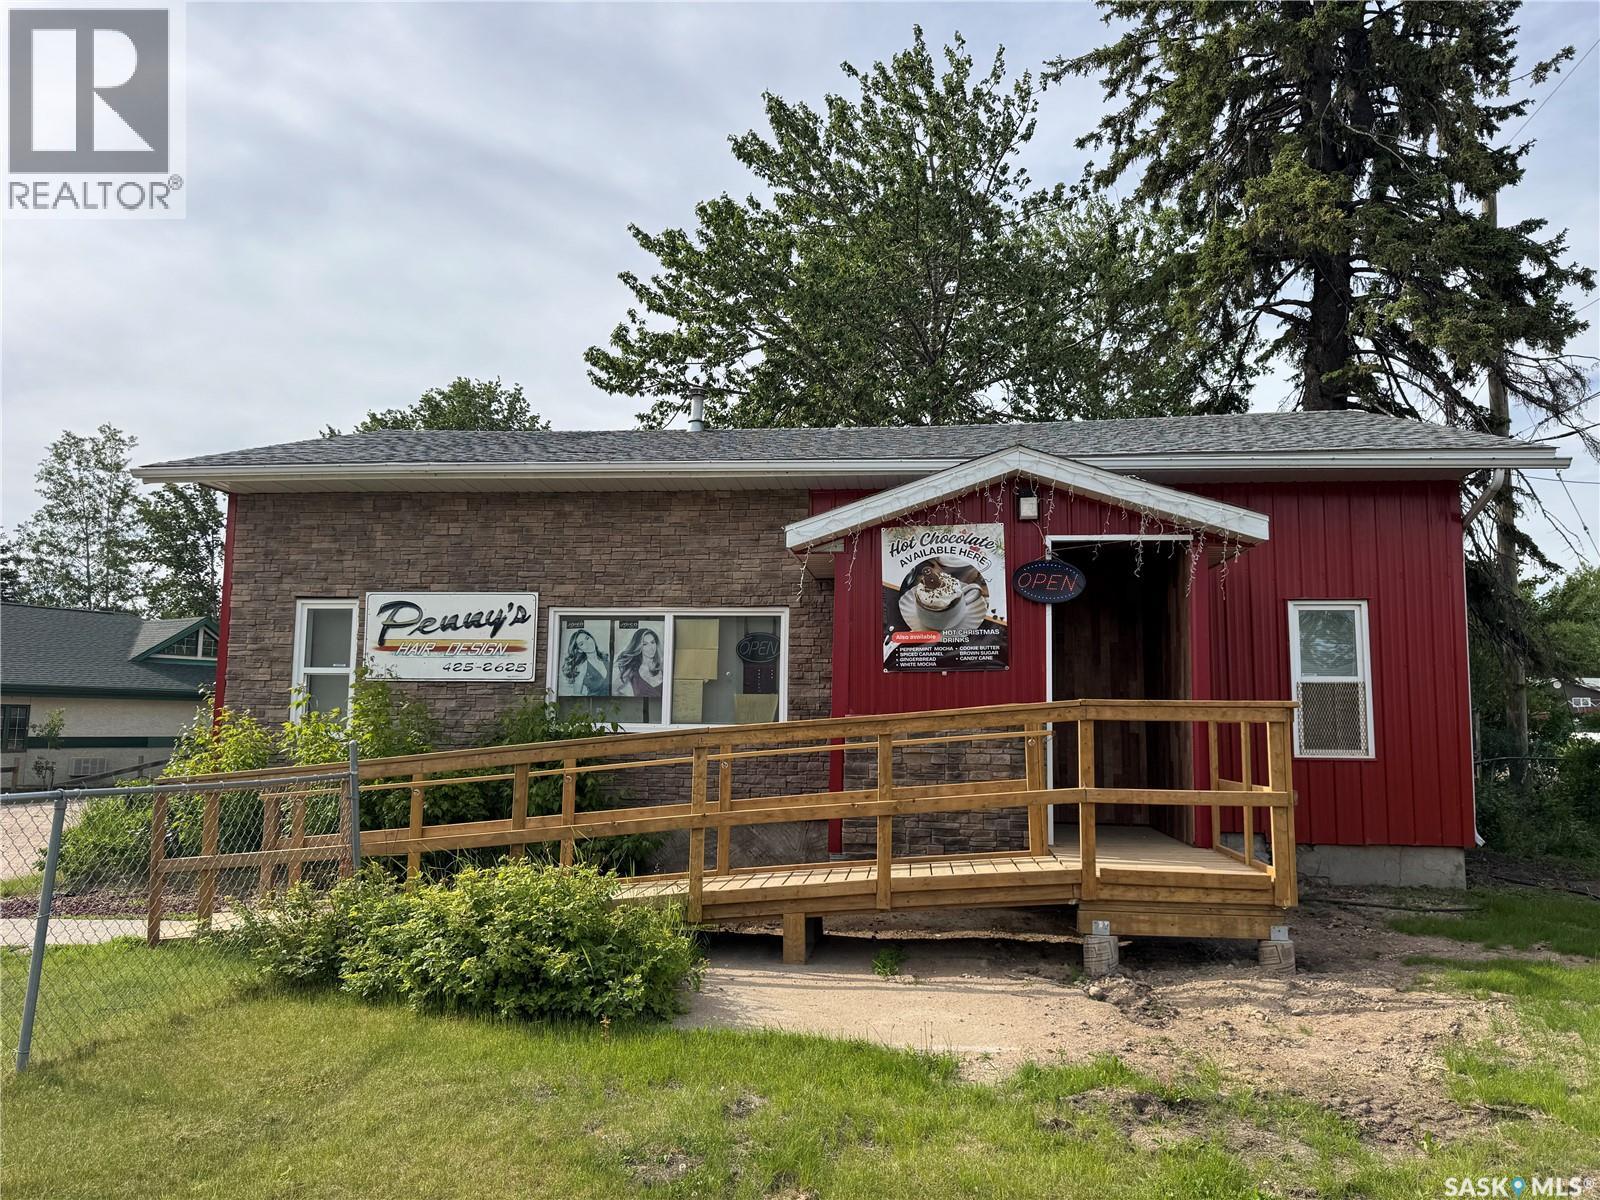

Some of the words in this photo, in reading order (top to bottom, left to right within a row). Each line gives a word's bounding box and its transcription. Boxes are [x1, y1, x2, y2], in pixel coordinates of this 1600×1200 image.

[889, 536, 917, 557] Hot
[919, 532, 995, 550] Chocolate
[899, 546, 957, 568] AVAILABLE
[958, 547, 988, 565] HERE
[1018, 572, 1078, 592] OPEN
[376, 600, 532, 646] Penny's
[394, 642, 437, 657] HAIR
[444, 642, 510, 657] DESIGN
[740, 640, 779, 656] OPEN
[442, 662, 528, 673] 425-2625
